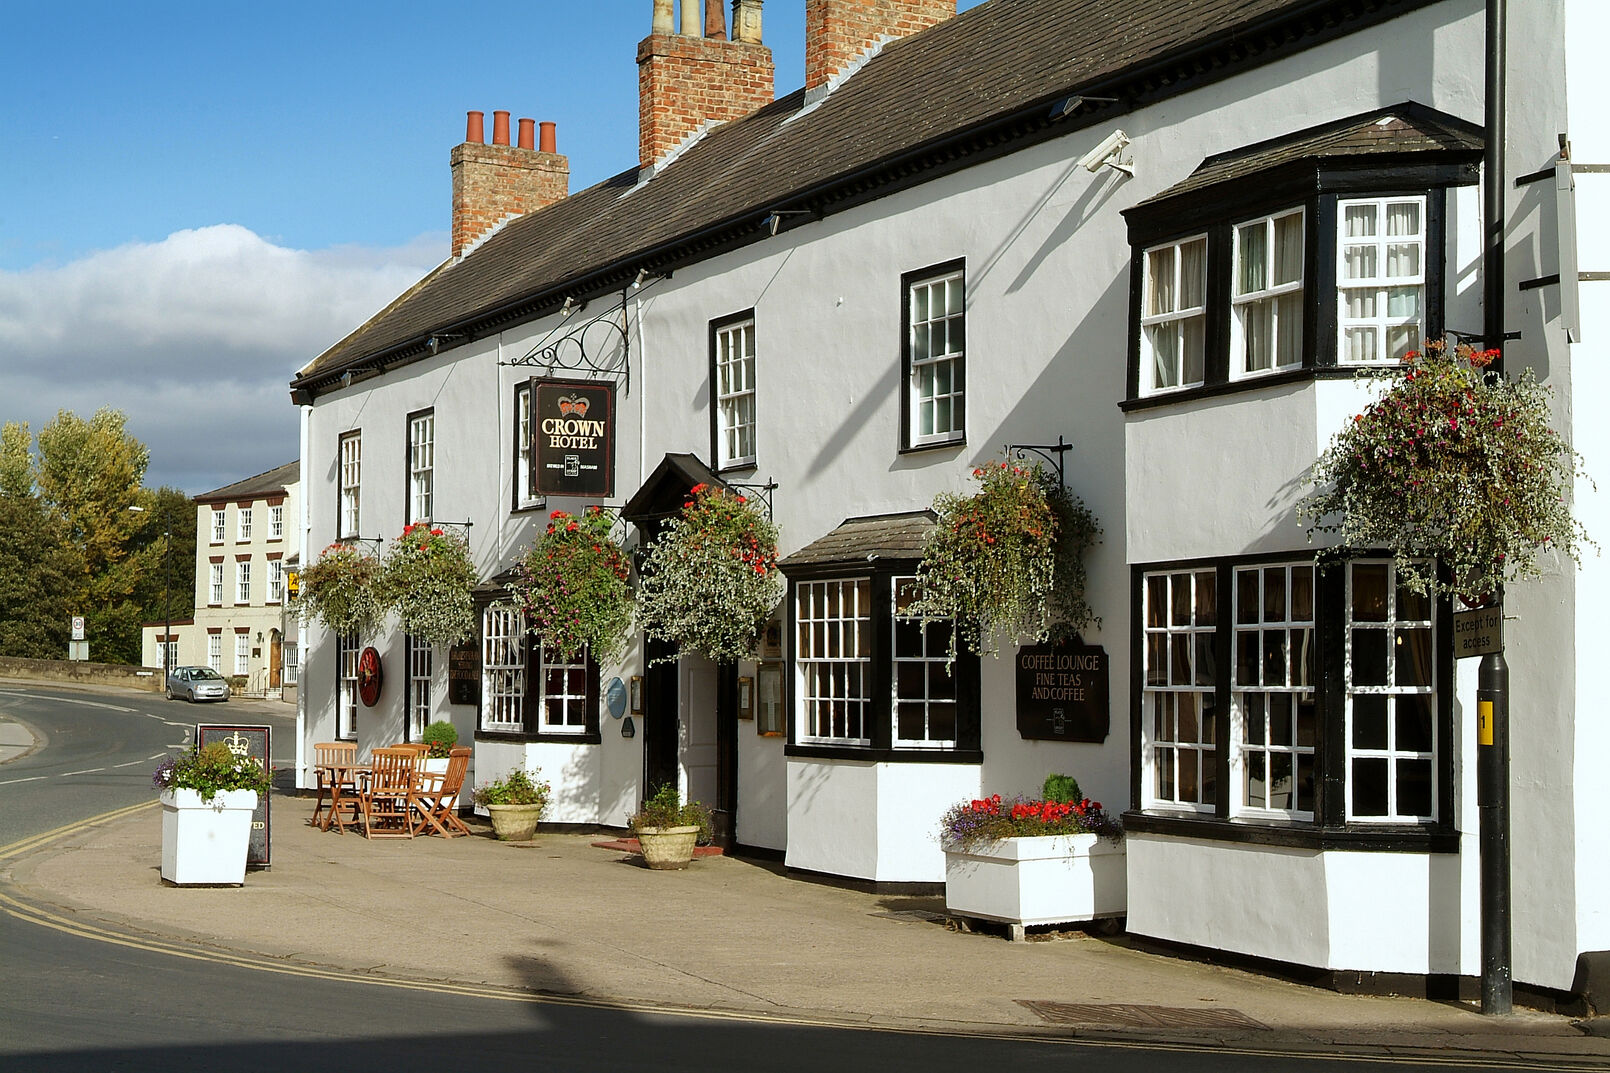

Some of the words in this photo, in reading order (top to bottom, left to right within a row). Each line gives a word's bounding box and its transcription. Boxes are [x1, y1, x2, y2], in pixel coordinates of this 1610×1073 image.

[542, 418, 605, 437] CROWN
[549, 435, 597, 449] HOTEL
[1455, 617, 1484, 633] Except
[1485, 615, 1498, 629] for
[1463, 636, 1491, 649] access
[1021, 654, 1055, 670] COFFEE
[1057, 655, 1099, 670] LOUNGE
[1036, 672, 1056, 686] FINE
[1057, 673, 1081, 686] TEAS
[1031, 687, 1050, 700] AND
[1050, 688, 1085, 701] COFFEE
[1480, 715, 1486, 729] 1
